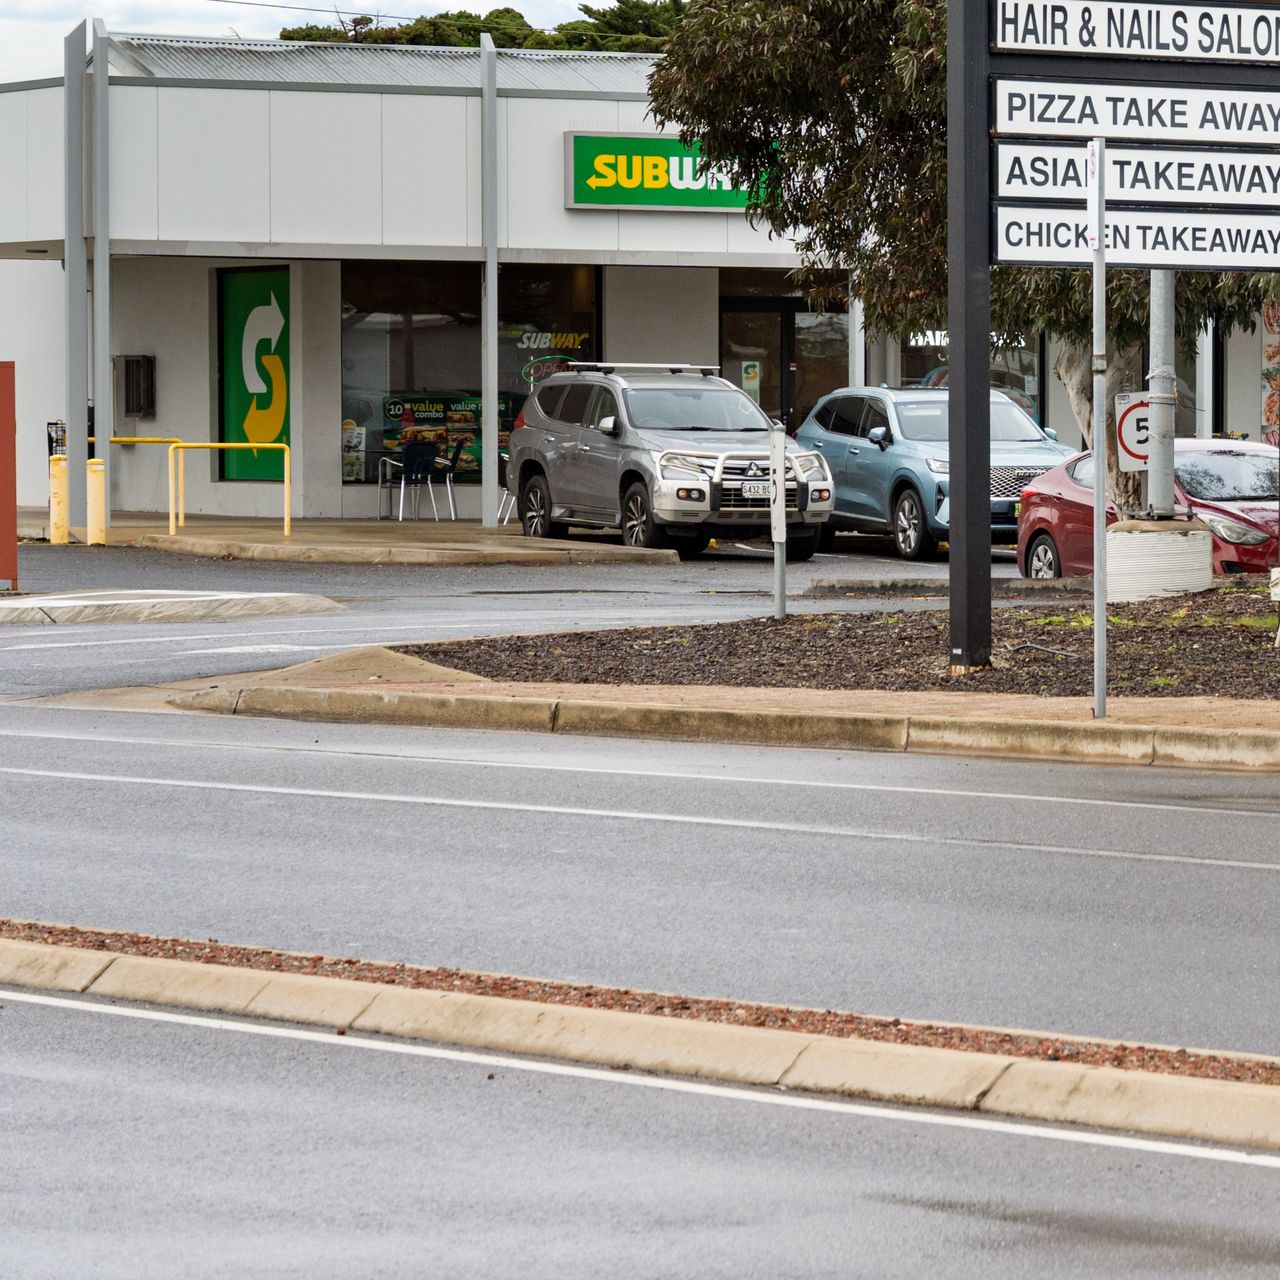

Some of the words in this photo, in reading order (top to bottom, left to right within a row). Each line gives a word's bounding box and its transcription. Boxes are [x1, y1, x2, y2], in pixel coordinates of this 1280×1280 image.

[1001, 2, 1068, 45] HAIR
[1078, 6, 1097, 47] &
[1107, 7, 1189, 52] NAILS
[1007, 92, 1099, 125] PIZZA
[1105, 96, 1188, 128] TAKE
[585, 154, 751, 191] SUBWA
[1005, 156, 1088, 188] ASIA
[517, 332, 590, 349] SUBWAY
[412, 401, 444, 413] value
[414, 409, 444, 419] combo
[450, 401, 477, 411] value
